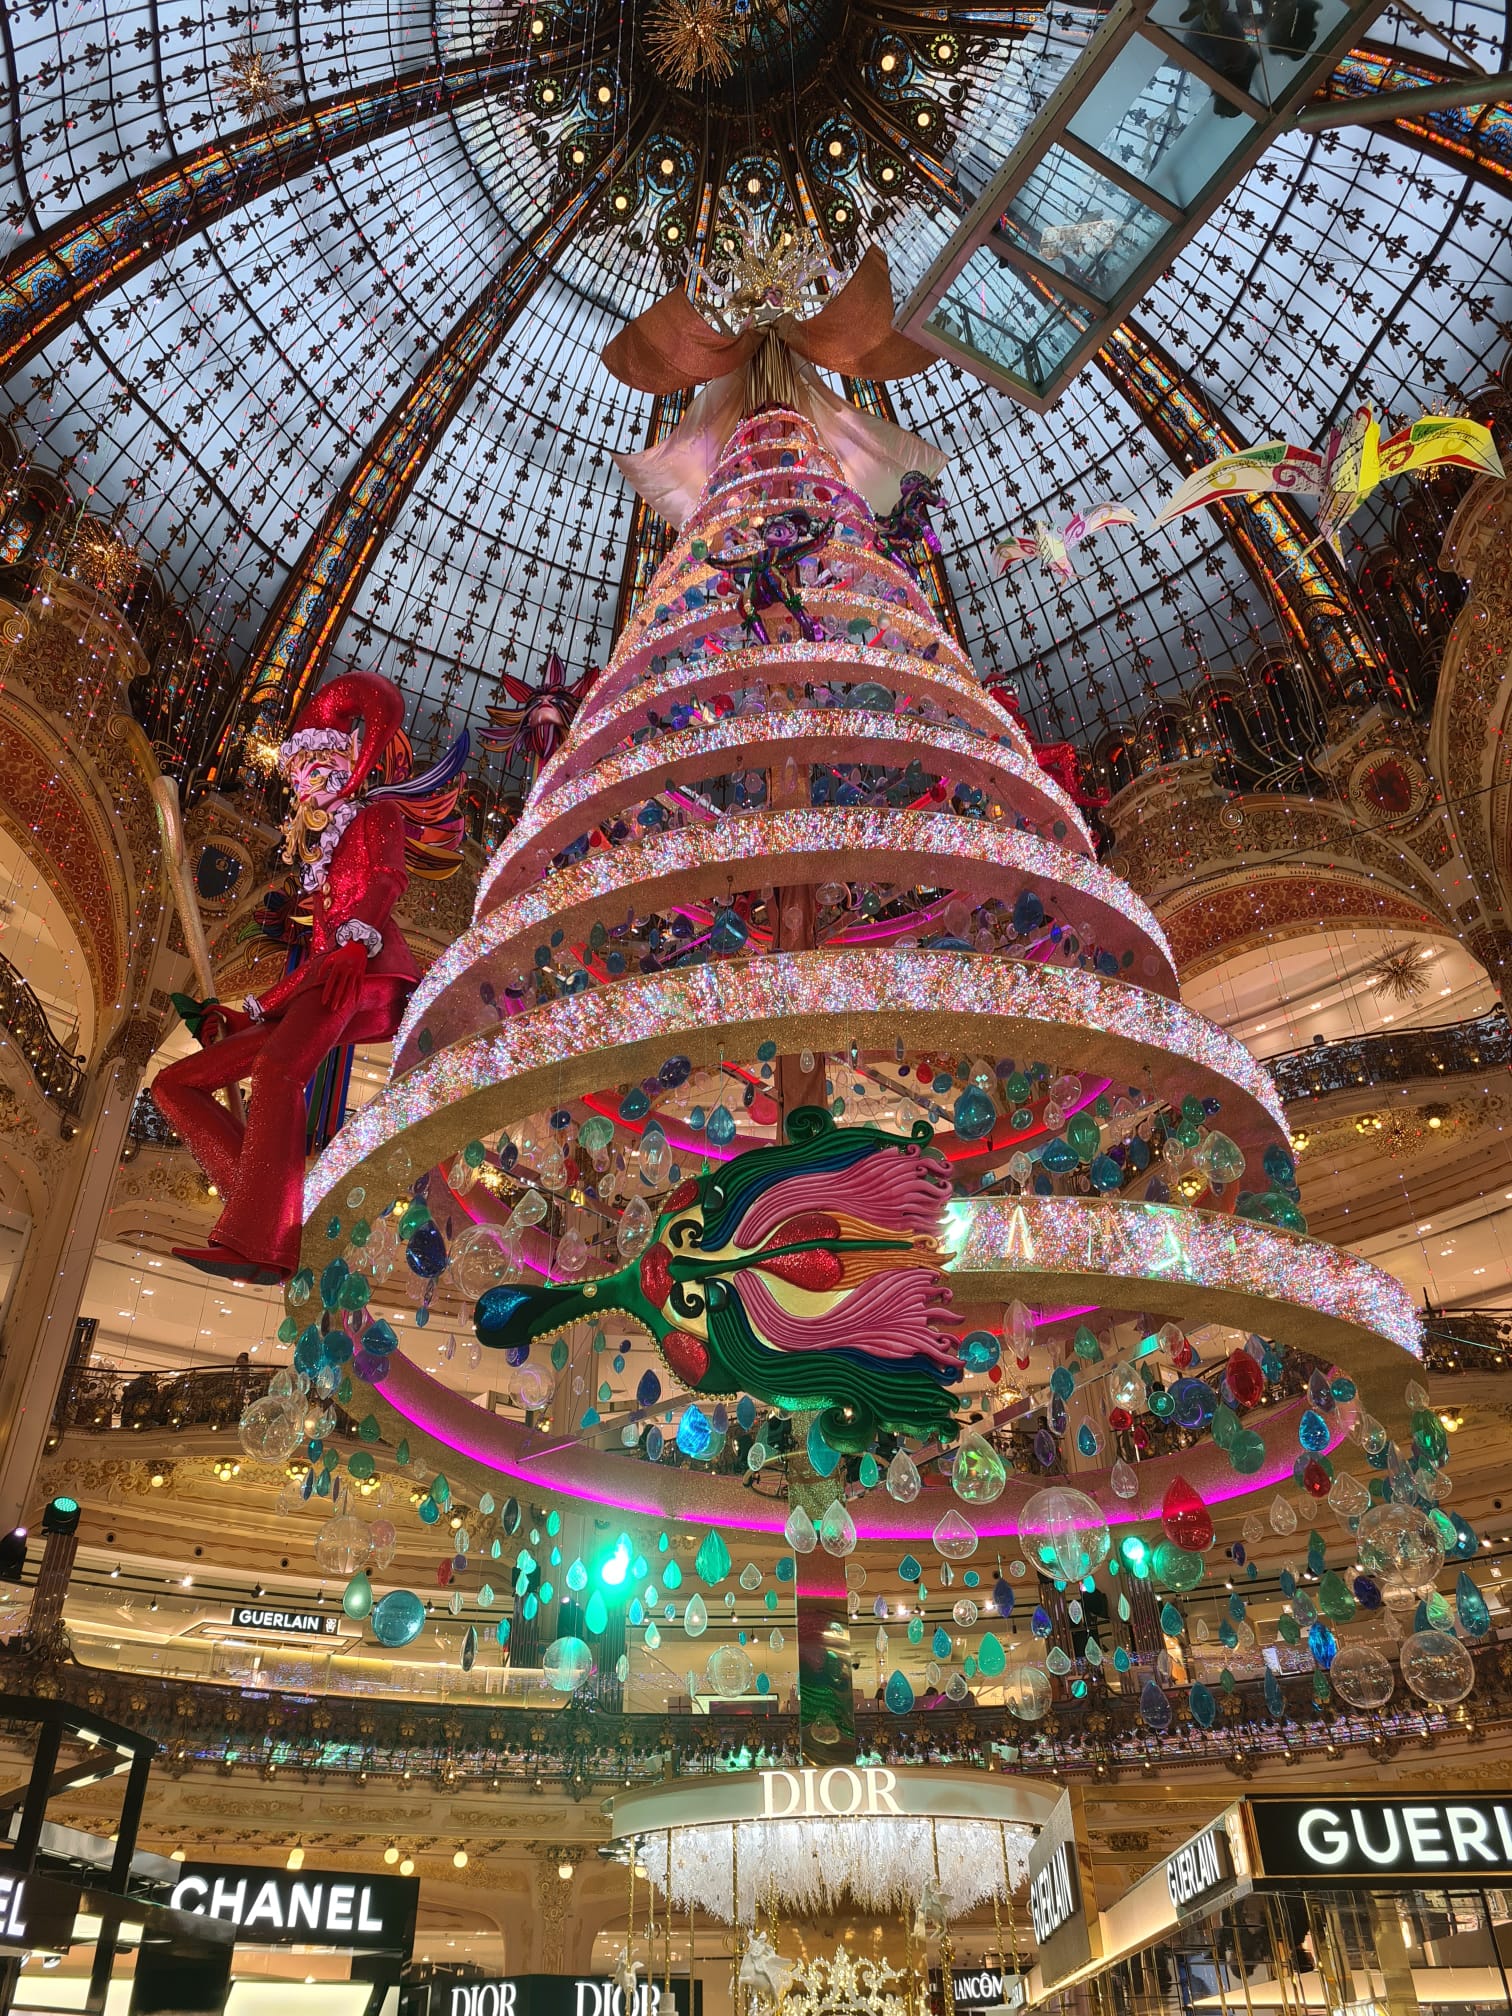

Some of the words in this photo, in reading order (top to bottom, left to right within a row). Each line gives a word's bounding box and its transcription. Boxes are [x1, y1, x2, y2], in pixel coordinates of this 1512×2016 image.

[239, 1609, 320, 1630] GUERLAIN
[759, 1767, 905, 1818] DIOR
[1166, 1829, 1222, 1908] GUERLAIN
[171, 1875, 383, 1932] CHANEL
[1031, 1840, 1075, 1945] GUERLAIN
[451, 1981, 517, 2016] DIOR
[574, 1981, 661, 2016] DIOR
[953, 1971, 1003, 2001] LANCÔM
